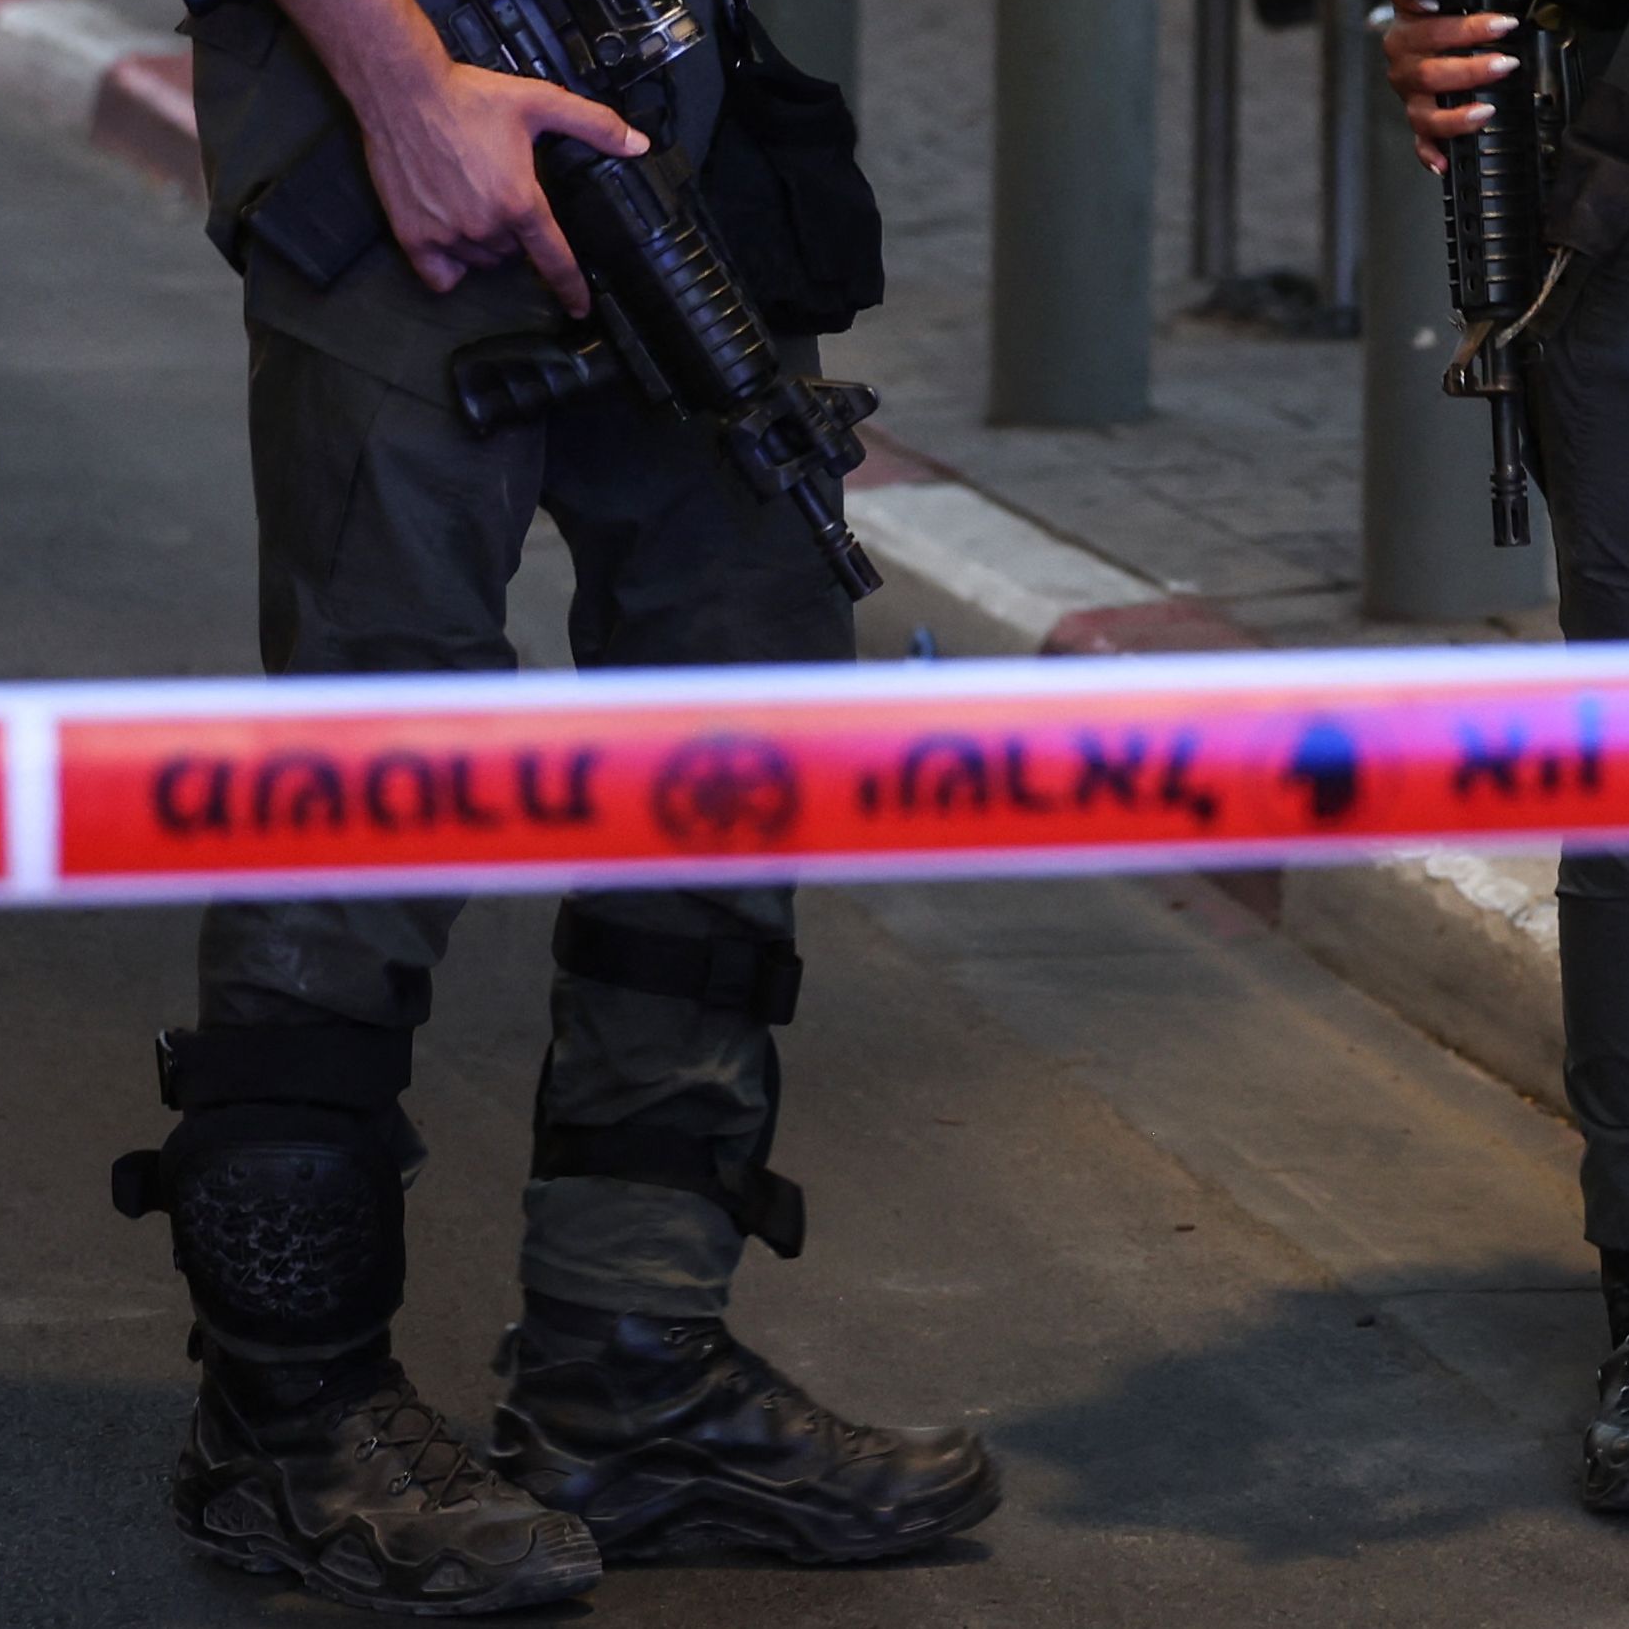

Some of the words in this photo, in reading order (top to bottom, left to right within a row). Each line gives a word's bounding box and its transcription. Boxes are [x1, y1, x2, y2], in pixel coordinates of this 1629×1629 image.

[153, 751, 597, 839] משטרת
[856, 732, 1219, 826] ישראל
[1451, 693, 1605, 801] אין
